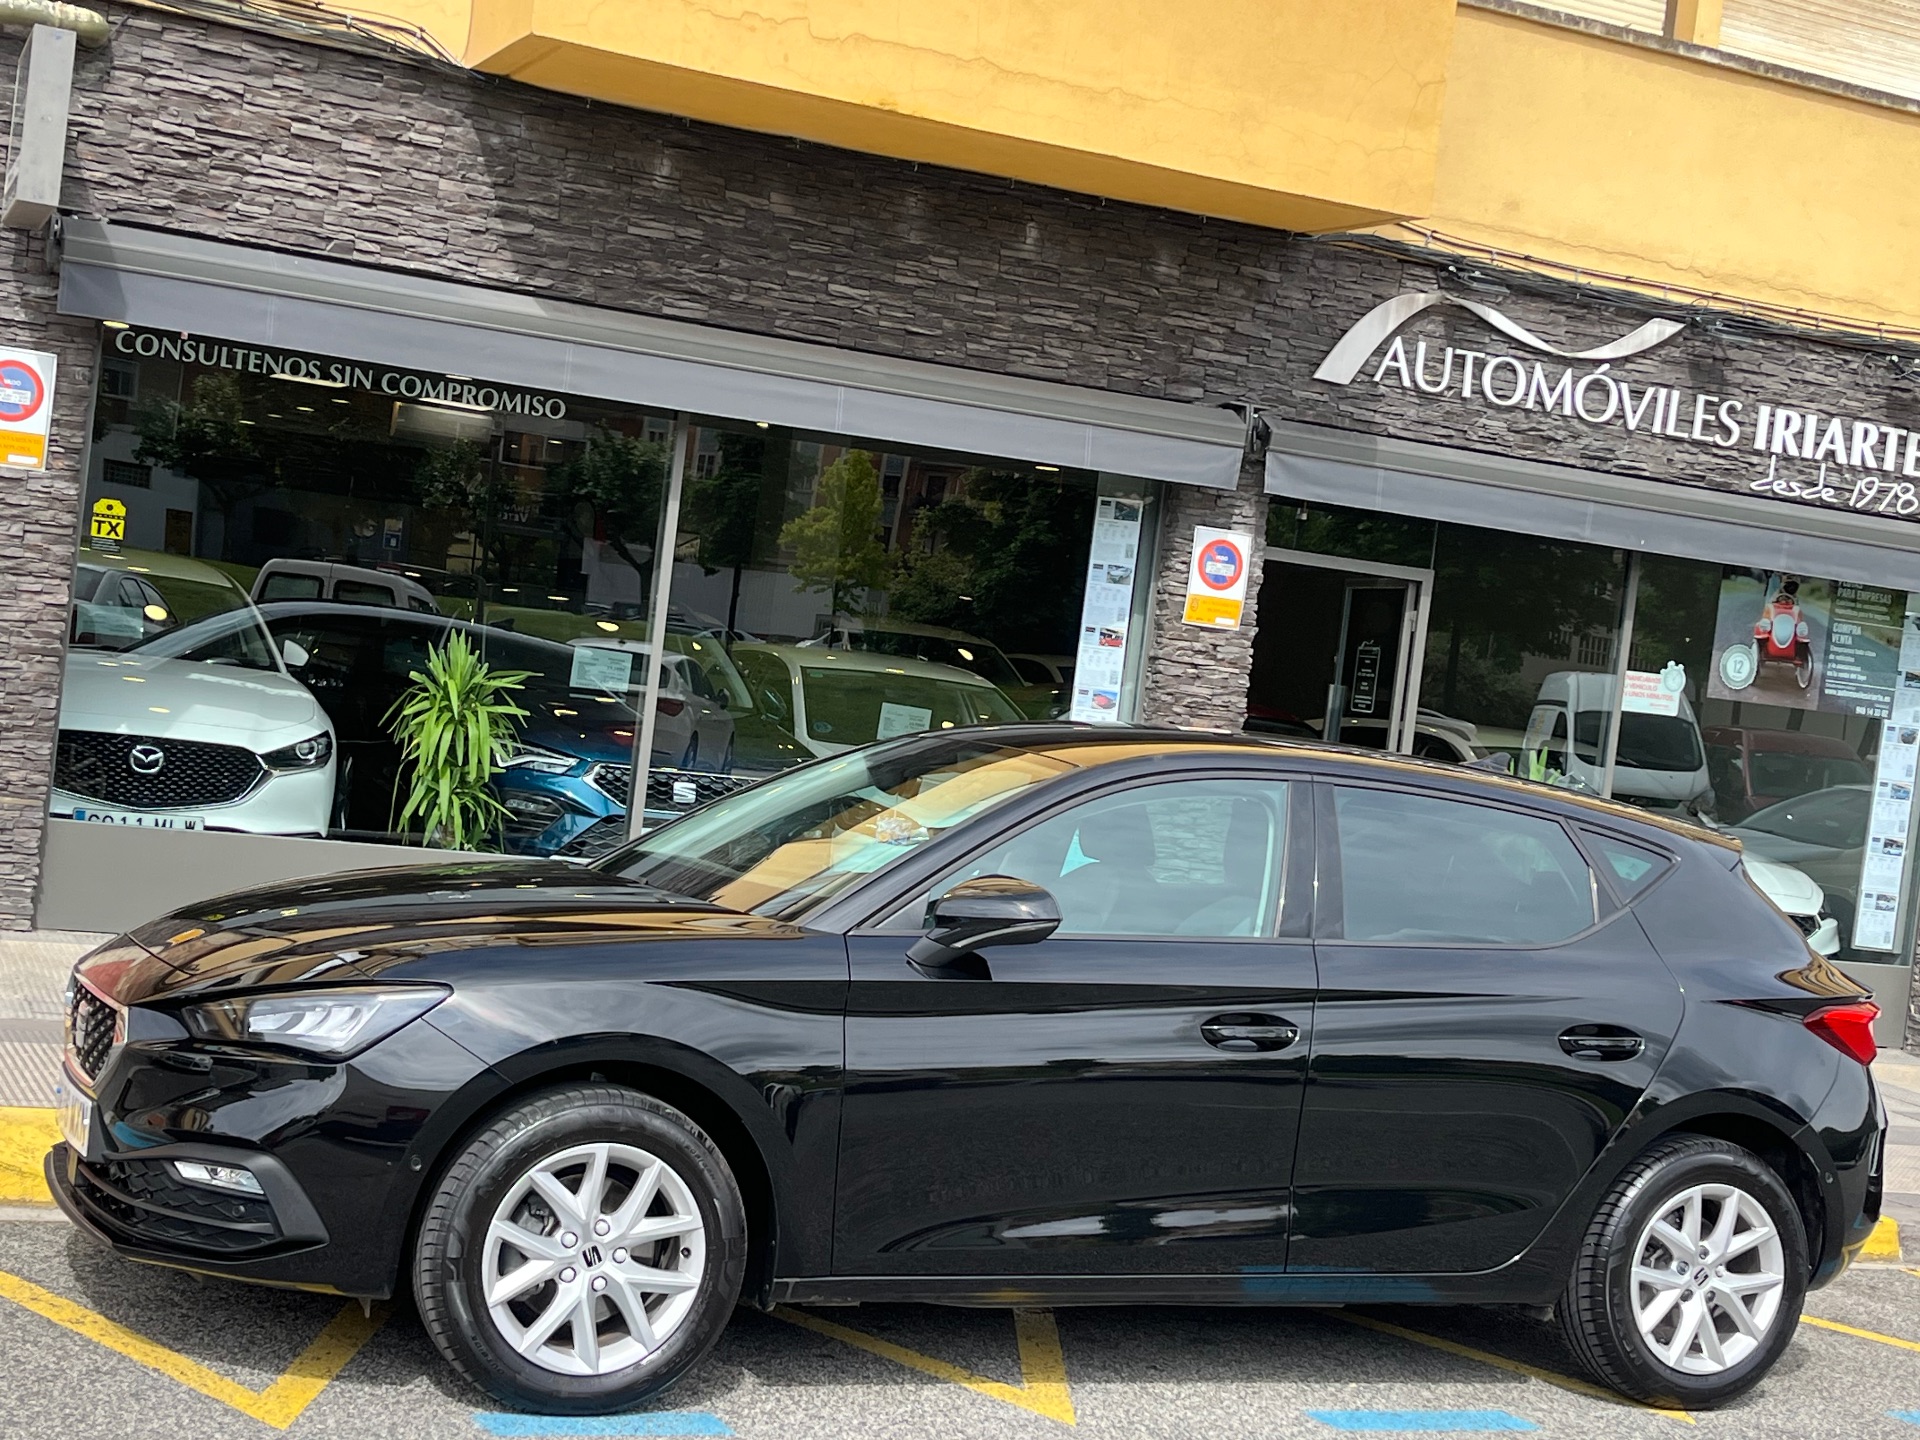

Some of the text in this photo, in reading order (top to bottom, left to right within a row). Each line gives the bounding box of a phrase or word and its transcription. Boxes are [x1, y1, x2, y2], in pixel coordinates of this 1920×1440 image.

[115, 331, 567, 420] CONSULTENOS SIN COMPROMISO
[1373, 335, 1920, 477] AUTOMÓVILES IRIARTE
[1750, 454, 1919, 514] desde 1978
[94, 520, 121, 537] TX
[1733, 659, 1744, 674] 12
